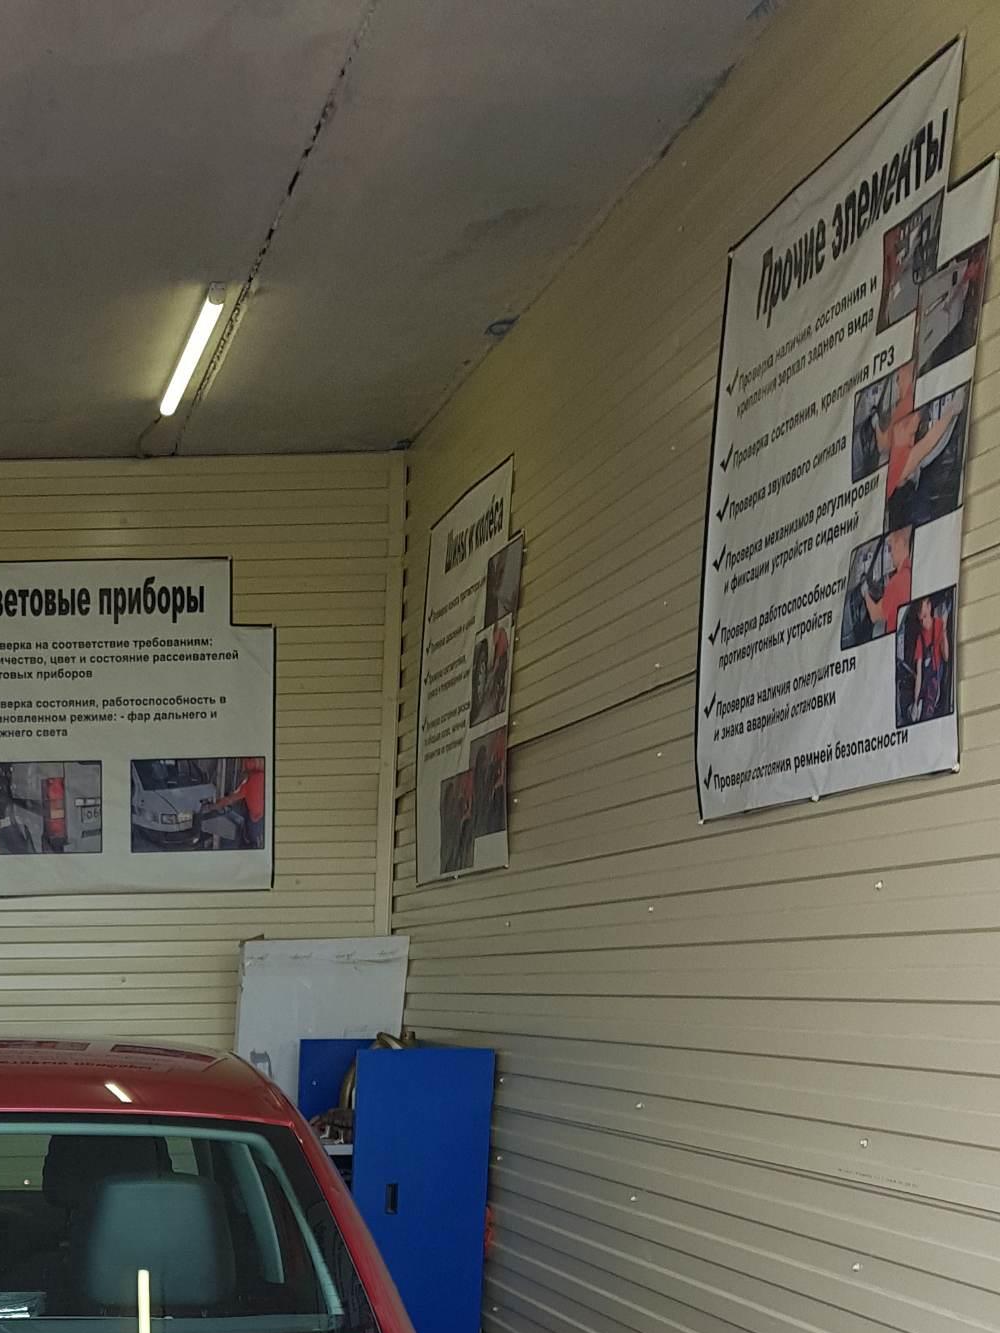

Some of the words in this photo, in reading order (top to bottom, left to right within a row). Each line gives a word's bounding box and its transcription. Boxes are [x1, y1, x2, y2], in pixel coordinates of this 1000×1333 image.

[756, 219, 826, 328] Прочие
[832, 108, 948, 260] элементы
[815, 282, 866, 332] состояния
[870, 276, 877, 293] и
[808, 328, 844, 365] заднего
[848, 308, 874, 337] вида
[733, 433, 769, 469] Проверка
[771, 402, 818, 442] состояния,
[873, 346, 894, 376] ГРЗ
[729, 486, 766, 520] Проверка
[768, 460, 811, 496] звукового
[813, 436, 846, 469] сигнала
[725, 538, 762, 570] Проверка
[764, 510, 814, 548] механизмов
[816, 474, 879, 524] регулировки
[724, 581, 728, 594] и
[731, 560, 770, 593] фиксации
[771, 537, 813, 575] устройств
[816, 512, 859, 547] сидений
[99, 576, 204, 624] приборы
[721, 616, 757, 646] Проверка
[759, 576, 846, 631] работоспособности
[50, 656, 76, 665] цвет
[90, 654, 149, 663] состояние
[153, 650, 238, 664] рассеивателей
[52, 640, 129, 649] соответствие
[133, 637, 212, 650] требованиям:
[719, 630, 785, 670] противоугонных
[787, 610, 832, 645] устройств
[37, 668, 92, 680] приборов
[716, 693, 754, 719] Проверка
[757, 680, 791, 704] наличия
[36, 700, 98, 708] состояния,
[102, 696, 216, 709] работоспособность
[220, 696, 226, 704] в
[70, 714, 116, 724] режиме:
[128, 712, 150, 722] фар
[153, 712, 207, 721] дальнего
[714, 730, 719, 741] и
[721, 722, 744, 740] знака
[746, 703, 789, 732] аварийной
[36, 729, 68, 737] света
[714, 770, 751, 792] Проверка
[794, 744, 832, 773] ремней
[835, 721, 908, 759] безопасности
